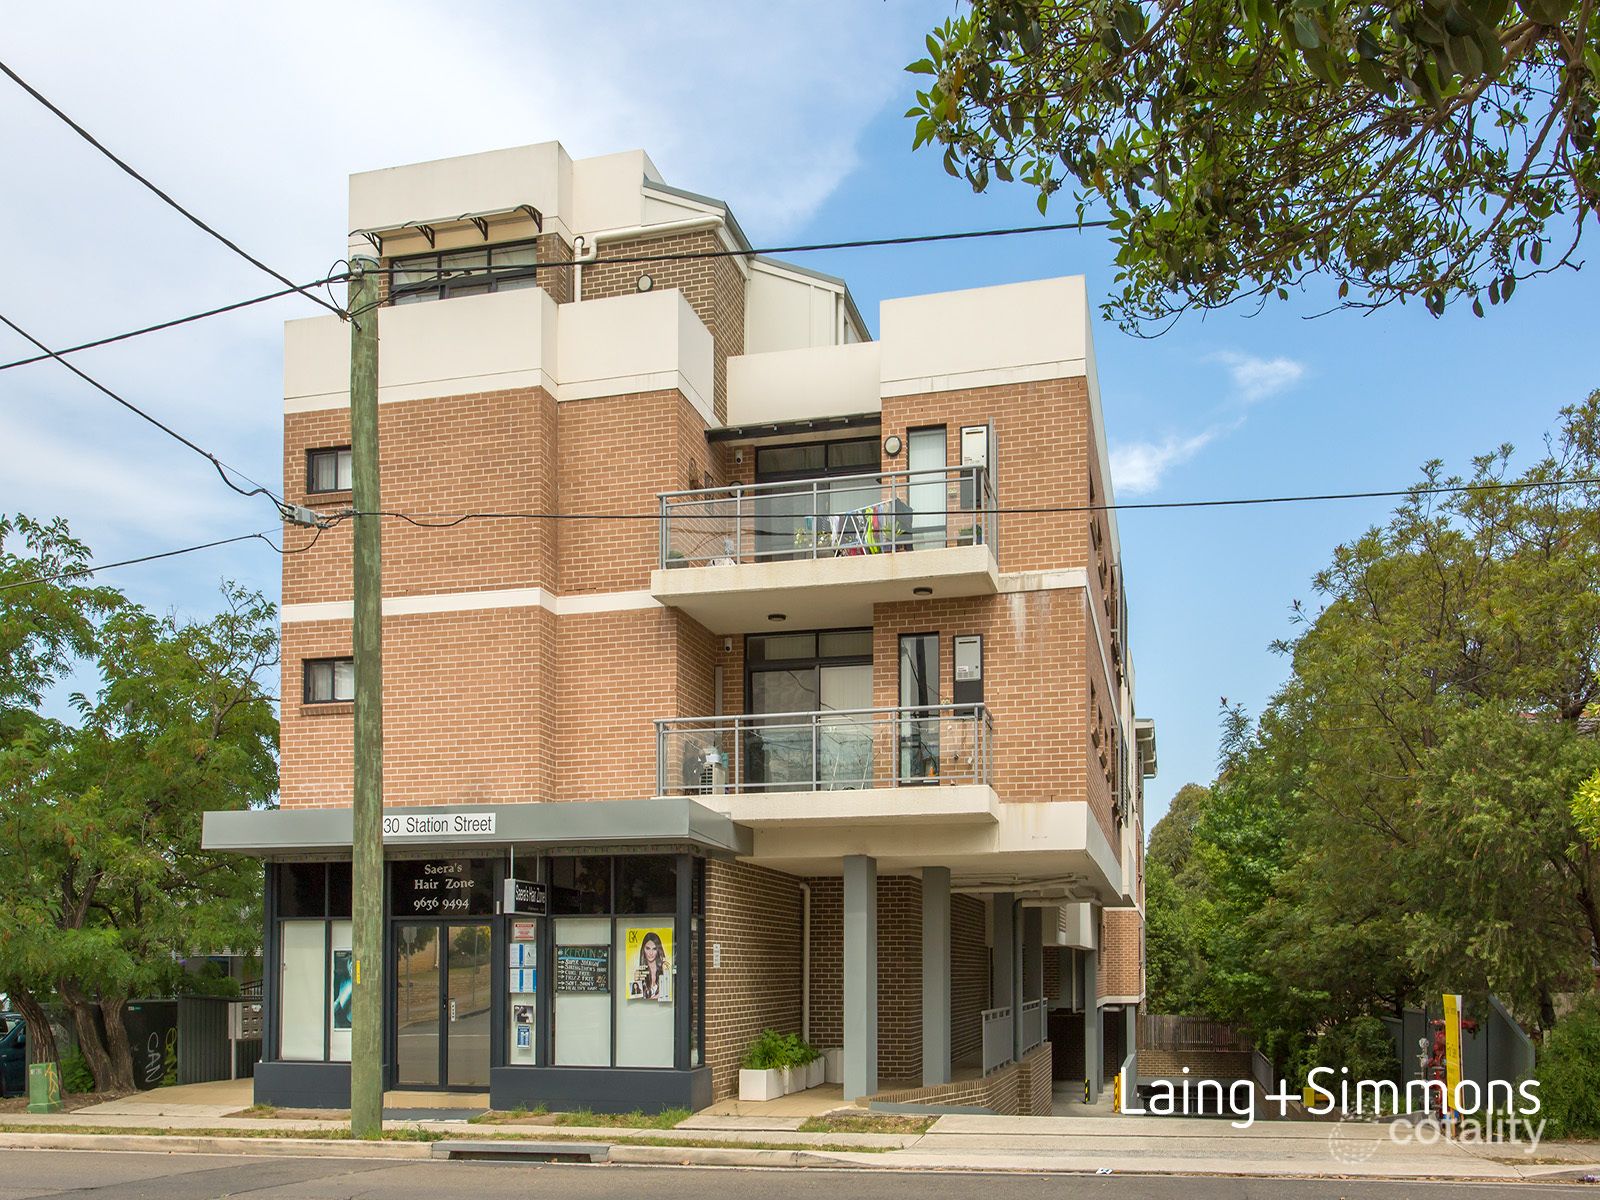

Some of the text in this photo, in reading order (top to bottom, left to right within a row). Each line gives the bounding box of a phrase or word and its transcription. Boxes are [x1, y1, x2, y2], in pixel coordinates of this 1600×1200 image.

[383, 815, 492, 834] 30 Station Street
[424, 862, 463, 875] Saera's
[414, 878, 475, 890] Hair Zone
[413, 896, 469, 911] 9636 9494
